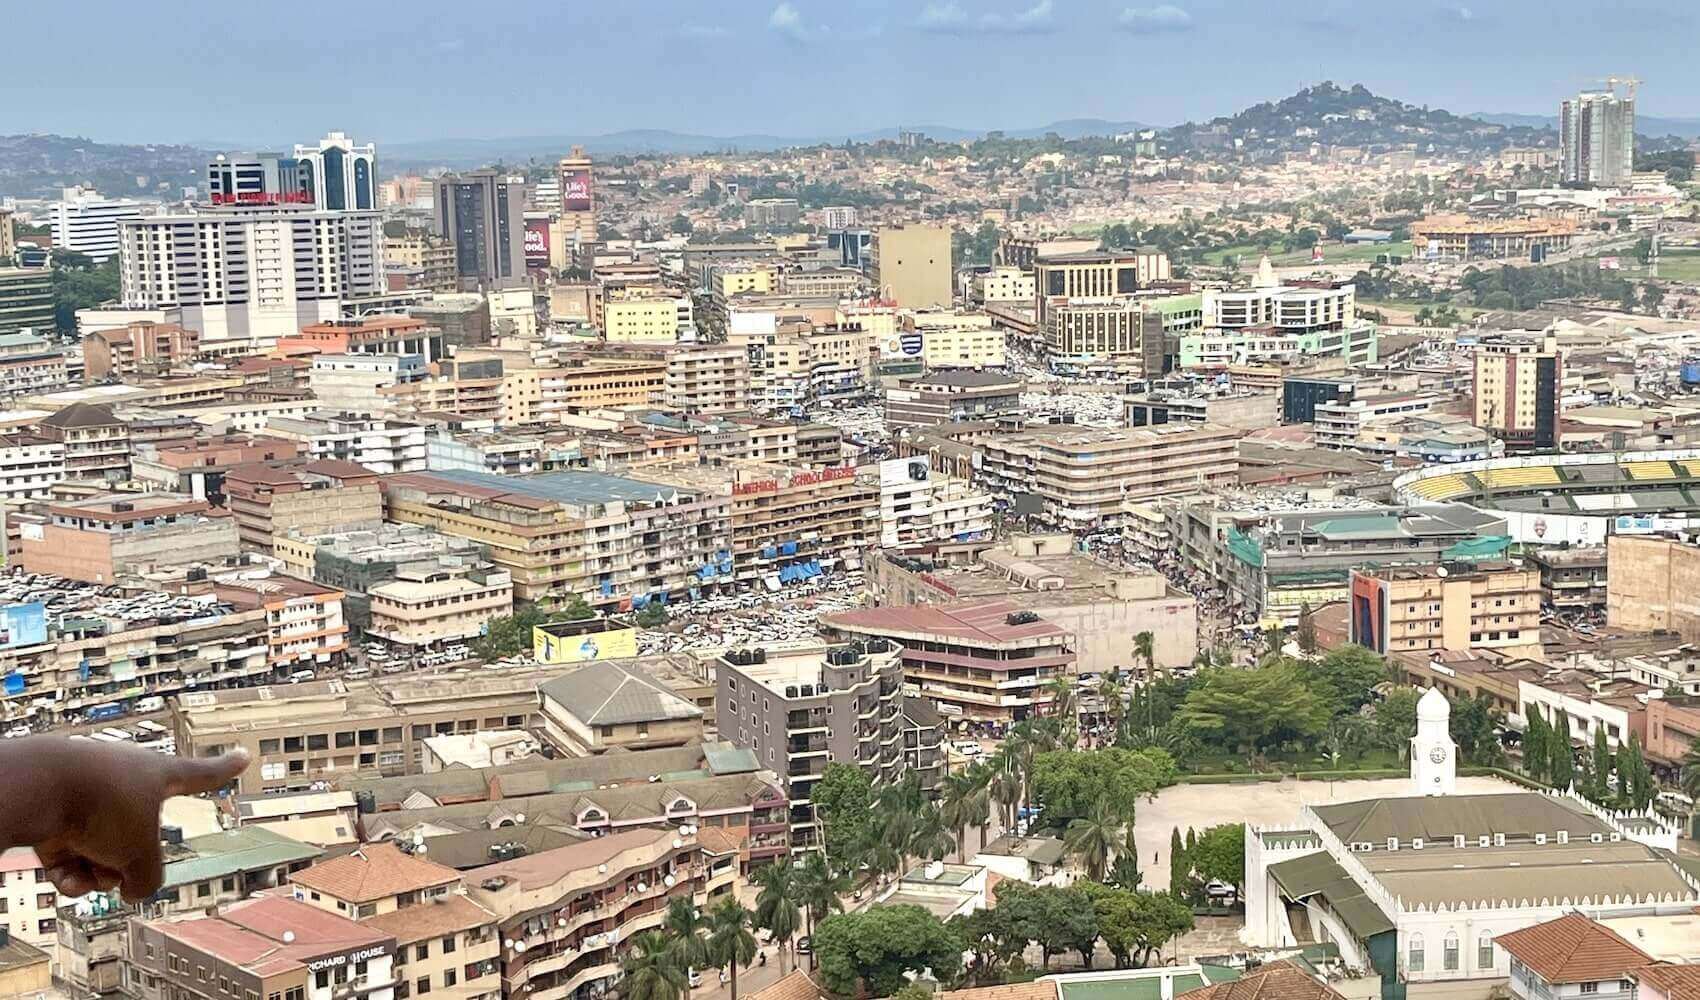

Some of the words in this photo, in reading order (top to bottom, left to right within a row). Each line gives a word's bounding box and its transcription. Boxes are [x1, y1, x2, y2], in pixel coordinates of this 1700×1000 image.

[566, 181, 587, 192] Life's
[565, 192, 589, 200] Good.
[525, 230, 543, 242] ife's
[525, 241, 547, 251] ood.
[307, 954, 346, 974] RICHARD
[350, 946, 385, 964] HOUSE
